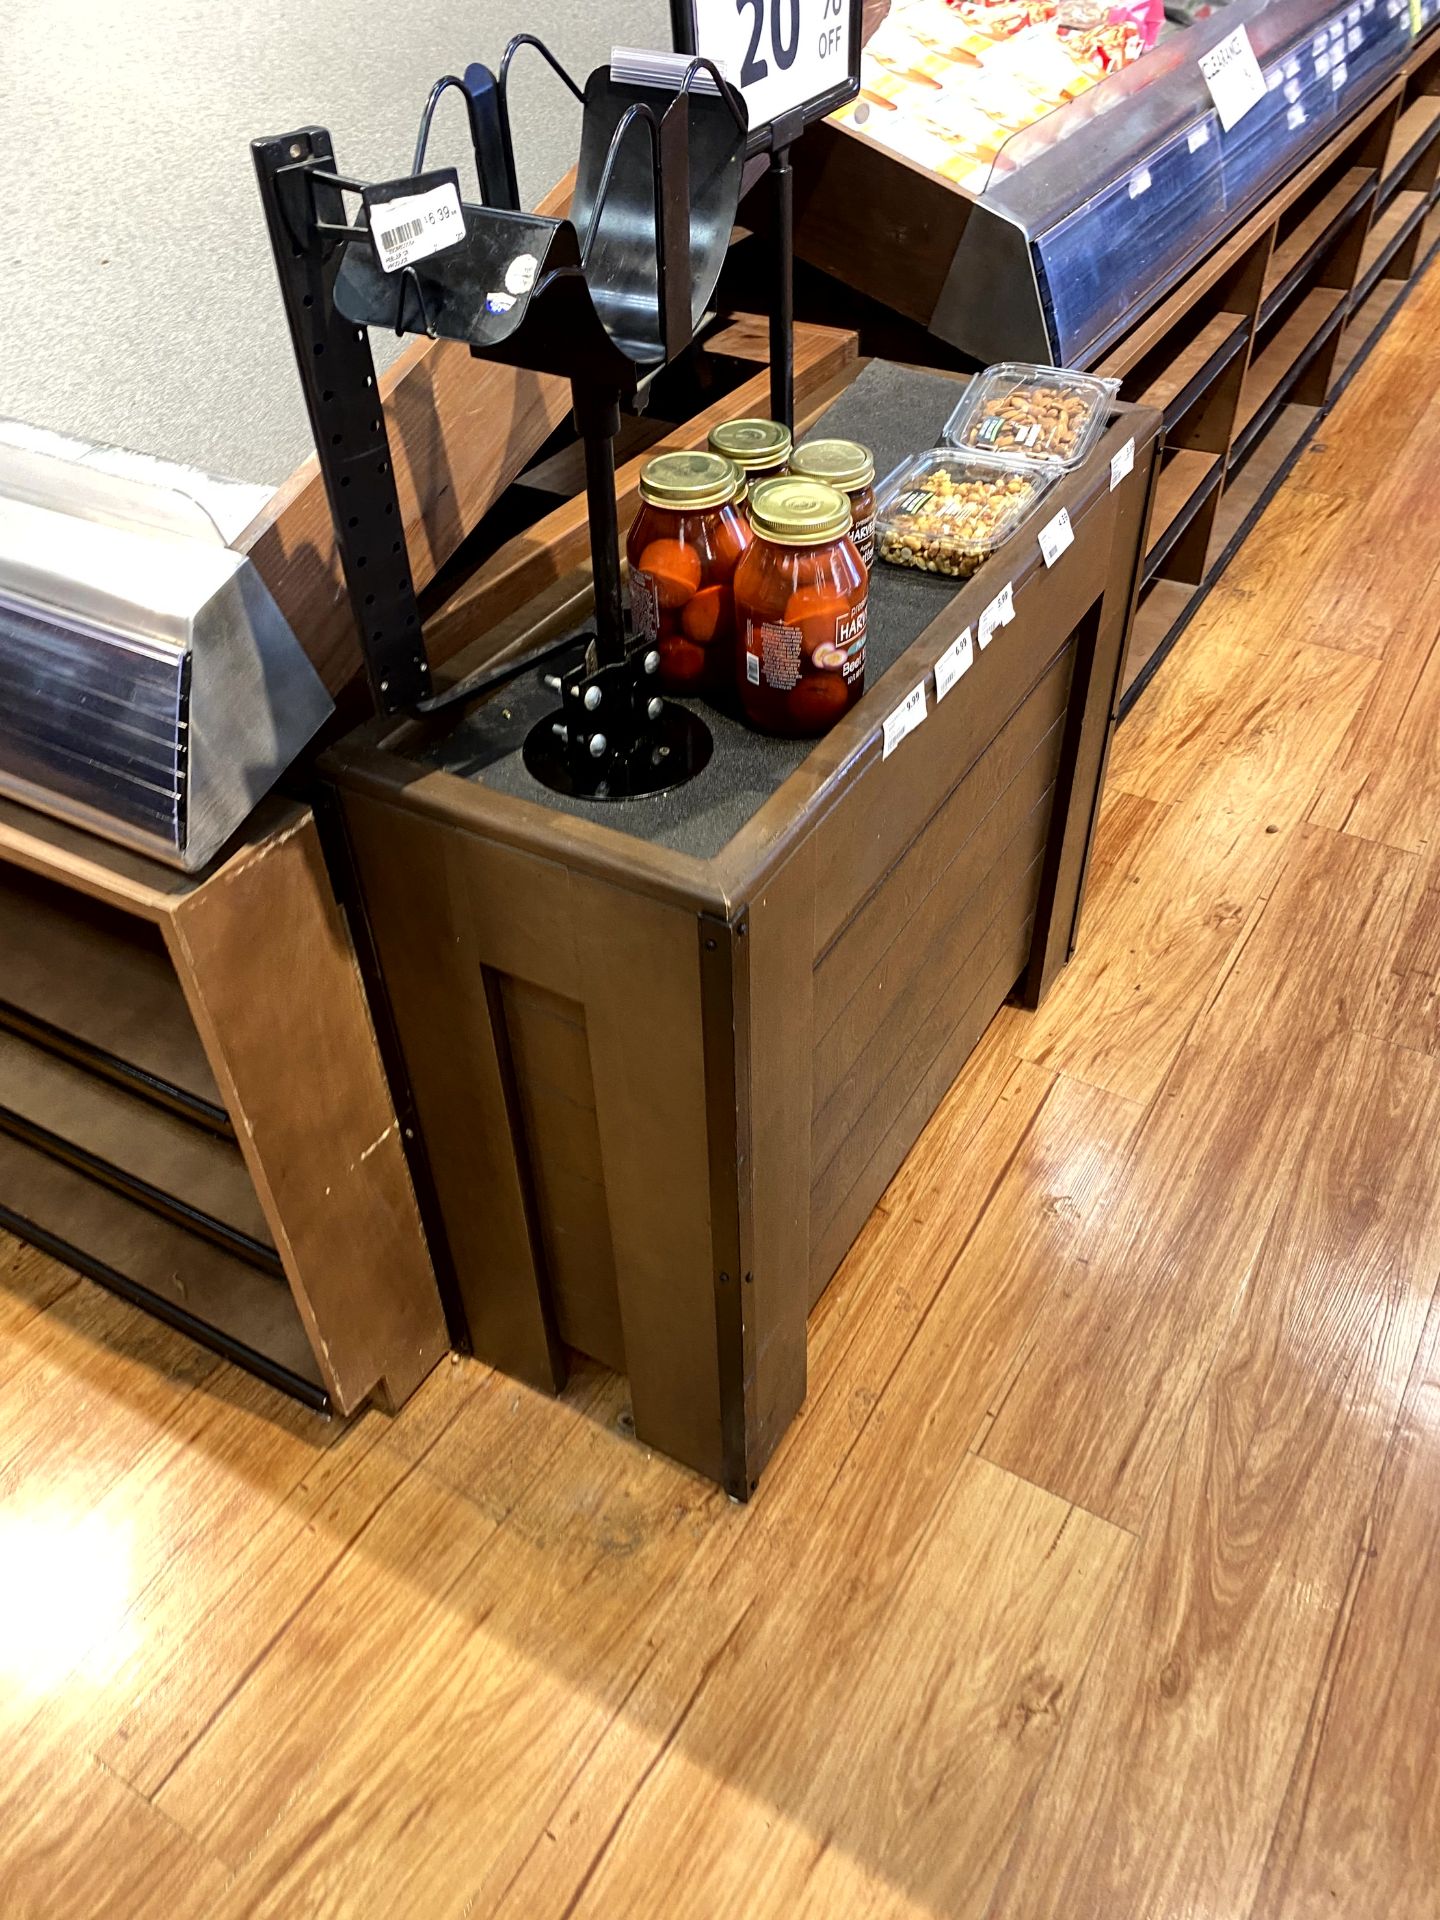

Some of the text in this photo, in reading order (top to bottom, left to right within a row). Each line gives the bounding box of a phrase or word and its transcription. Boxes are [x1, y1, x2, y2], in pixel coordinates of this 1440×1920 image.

[736, 0, 800, 89] 20
[818, 25, 842, 59] OFF
[955, 637, 968, 656] 6.99
[906, 691, 920, 711] 9.99
